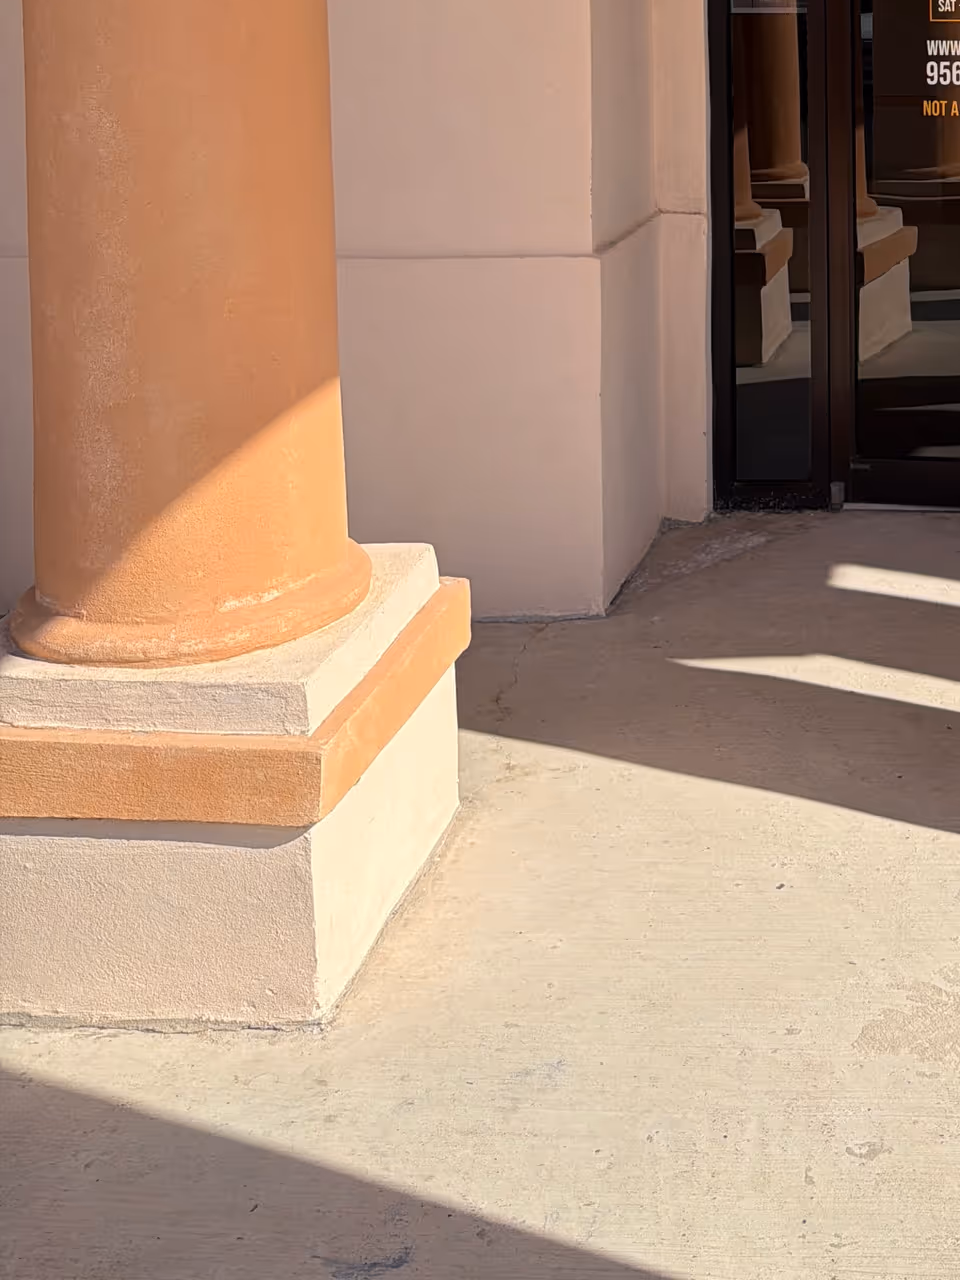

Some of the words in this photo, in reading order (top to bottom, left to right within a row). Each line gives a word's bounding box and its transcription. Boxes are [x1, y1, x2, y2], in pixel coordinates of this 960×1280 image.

[938, 0, 956, 12] SAT
[923, 100, 948, 117] NOT
[951, 101, 959, 117] A
